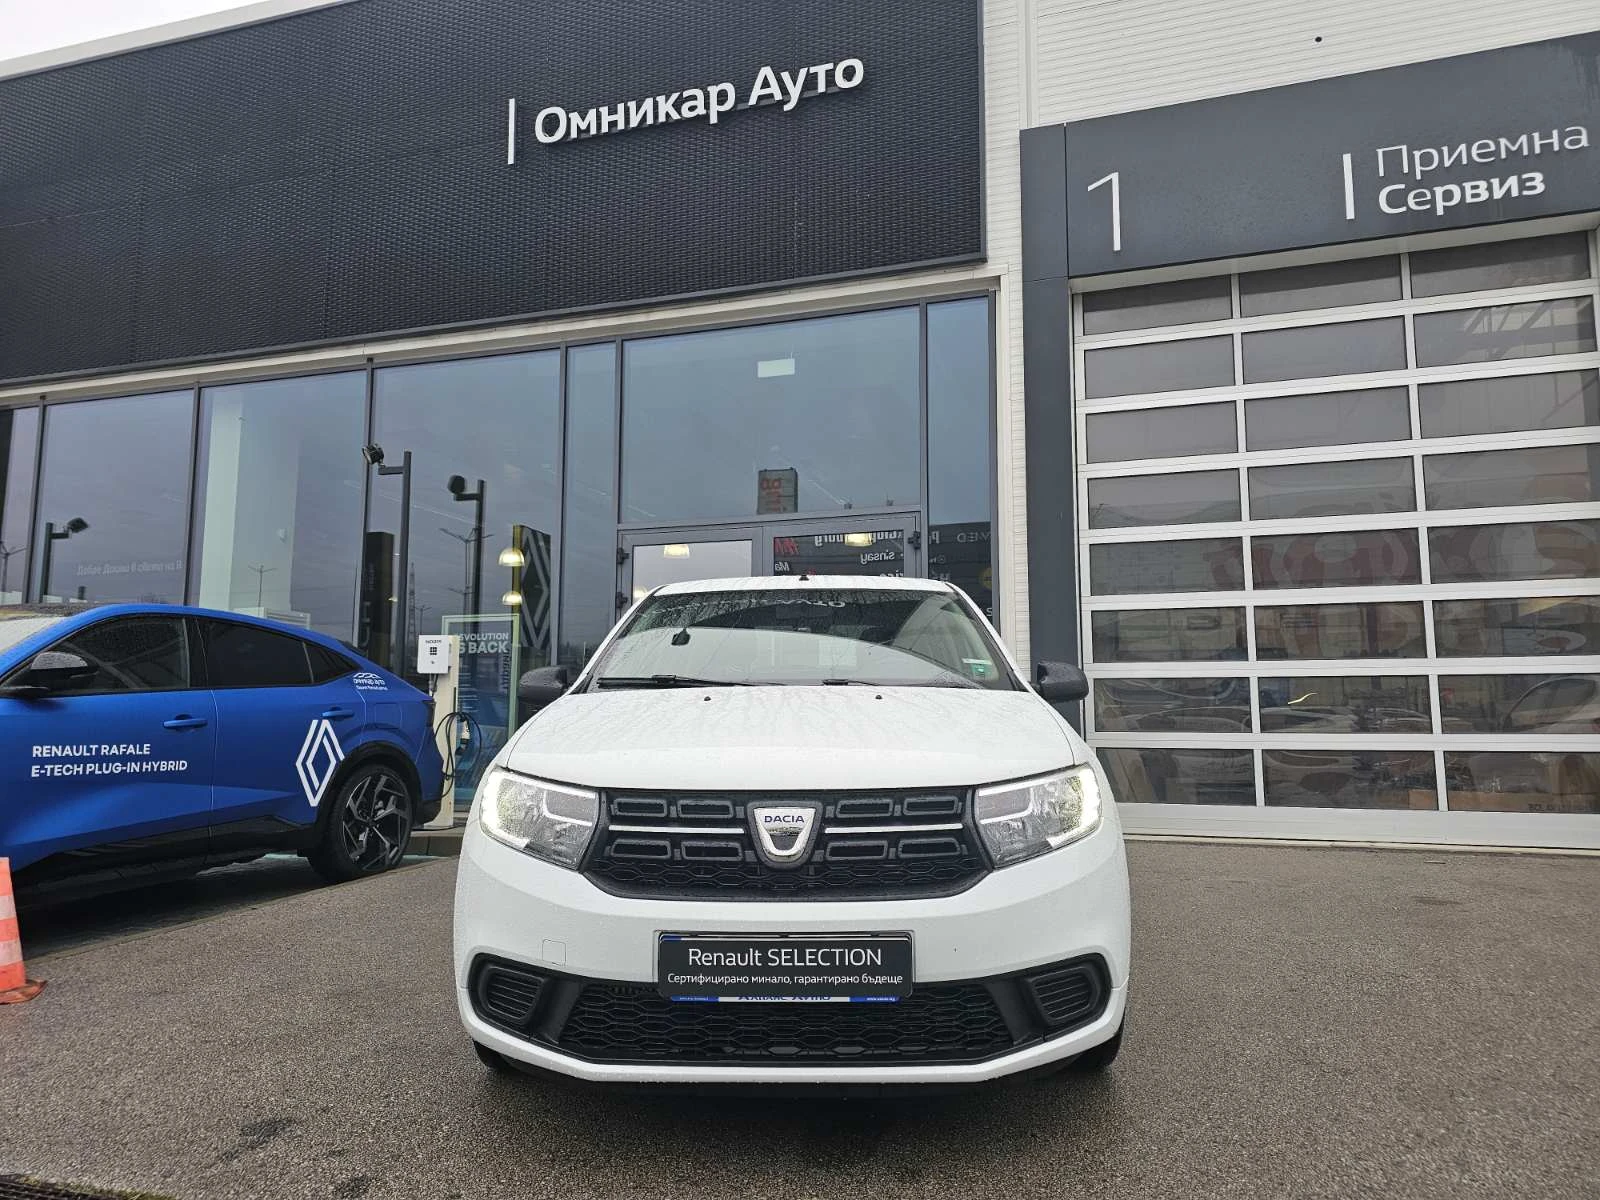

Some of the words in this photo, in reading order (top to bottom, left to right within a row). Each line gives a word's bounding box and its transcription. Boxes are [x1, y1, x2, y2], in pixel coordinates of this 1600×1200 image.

[534, 82, 736, 144] Омникар
[748, 58, 865, 112] Ауто
[1375, 126, 1591, 179] Приемна
[1378, 171, 1547, 216] Сервиз
[1087, 171, 1121, 253] 1
[458, 632, 509, 641] EVOLUTION
[468, 641, 508, 654] BACK
[32, 745, 98, 757] RENAULT
[100, 744, 151, 755] RAFALE
[31, 763, 83, 777] E-TECH
[85, 761, 140, 775] PLUG-IN
[142, 760, 188, 772] HYBRID
[764, 815, 805, 823] DACIA
[688, 947, 763, 967] Renault
[767, 947, 882, 967] SELECTION
[667, 972, 750, 985] Сертифицирано
[751, 975, 792, 986] минало,
[794, 975, 860, 986] гарантирано
[861, 972, 903, 986] бъдеще
